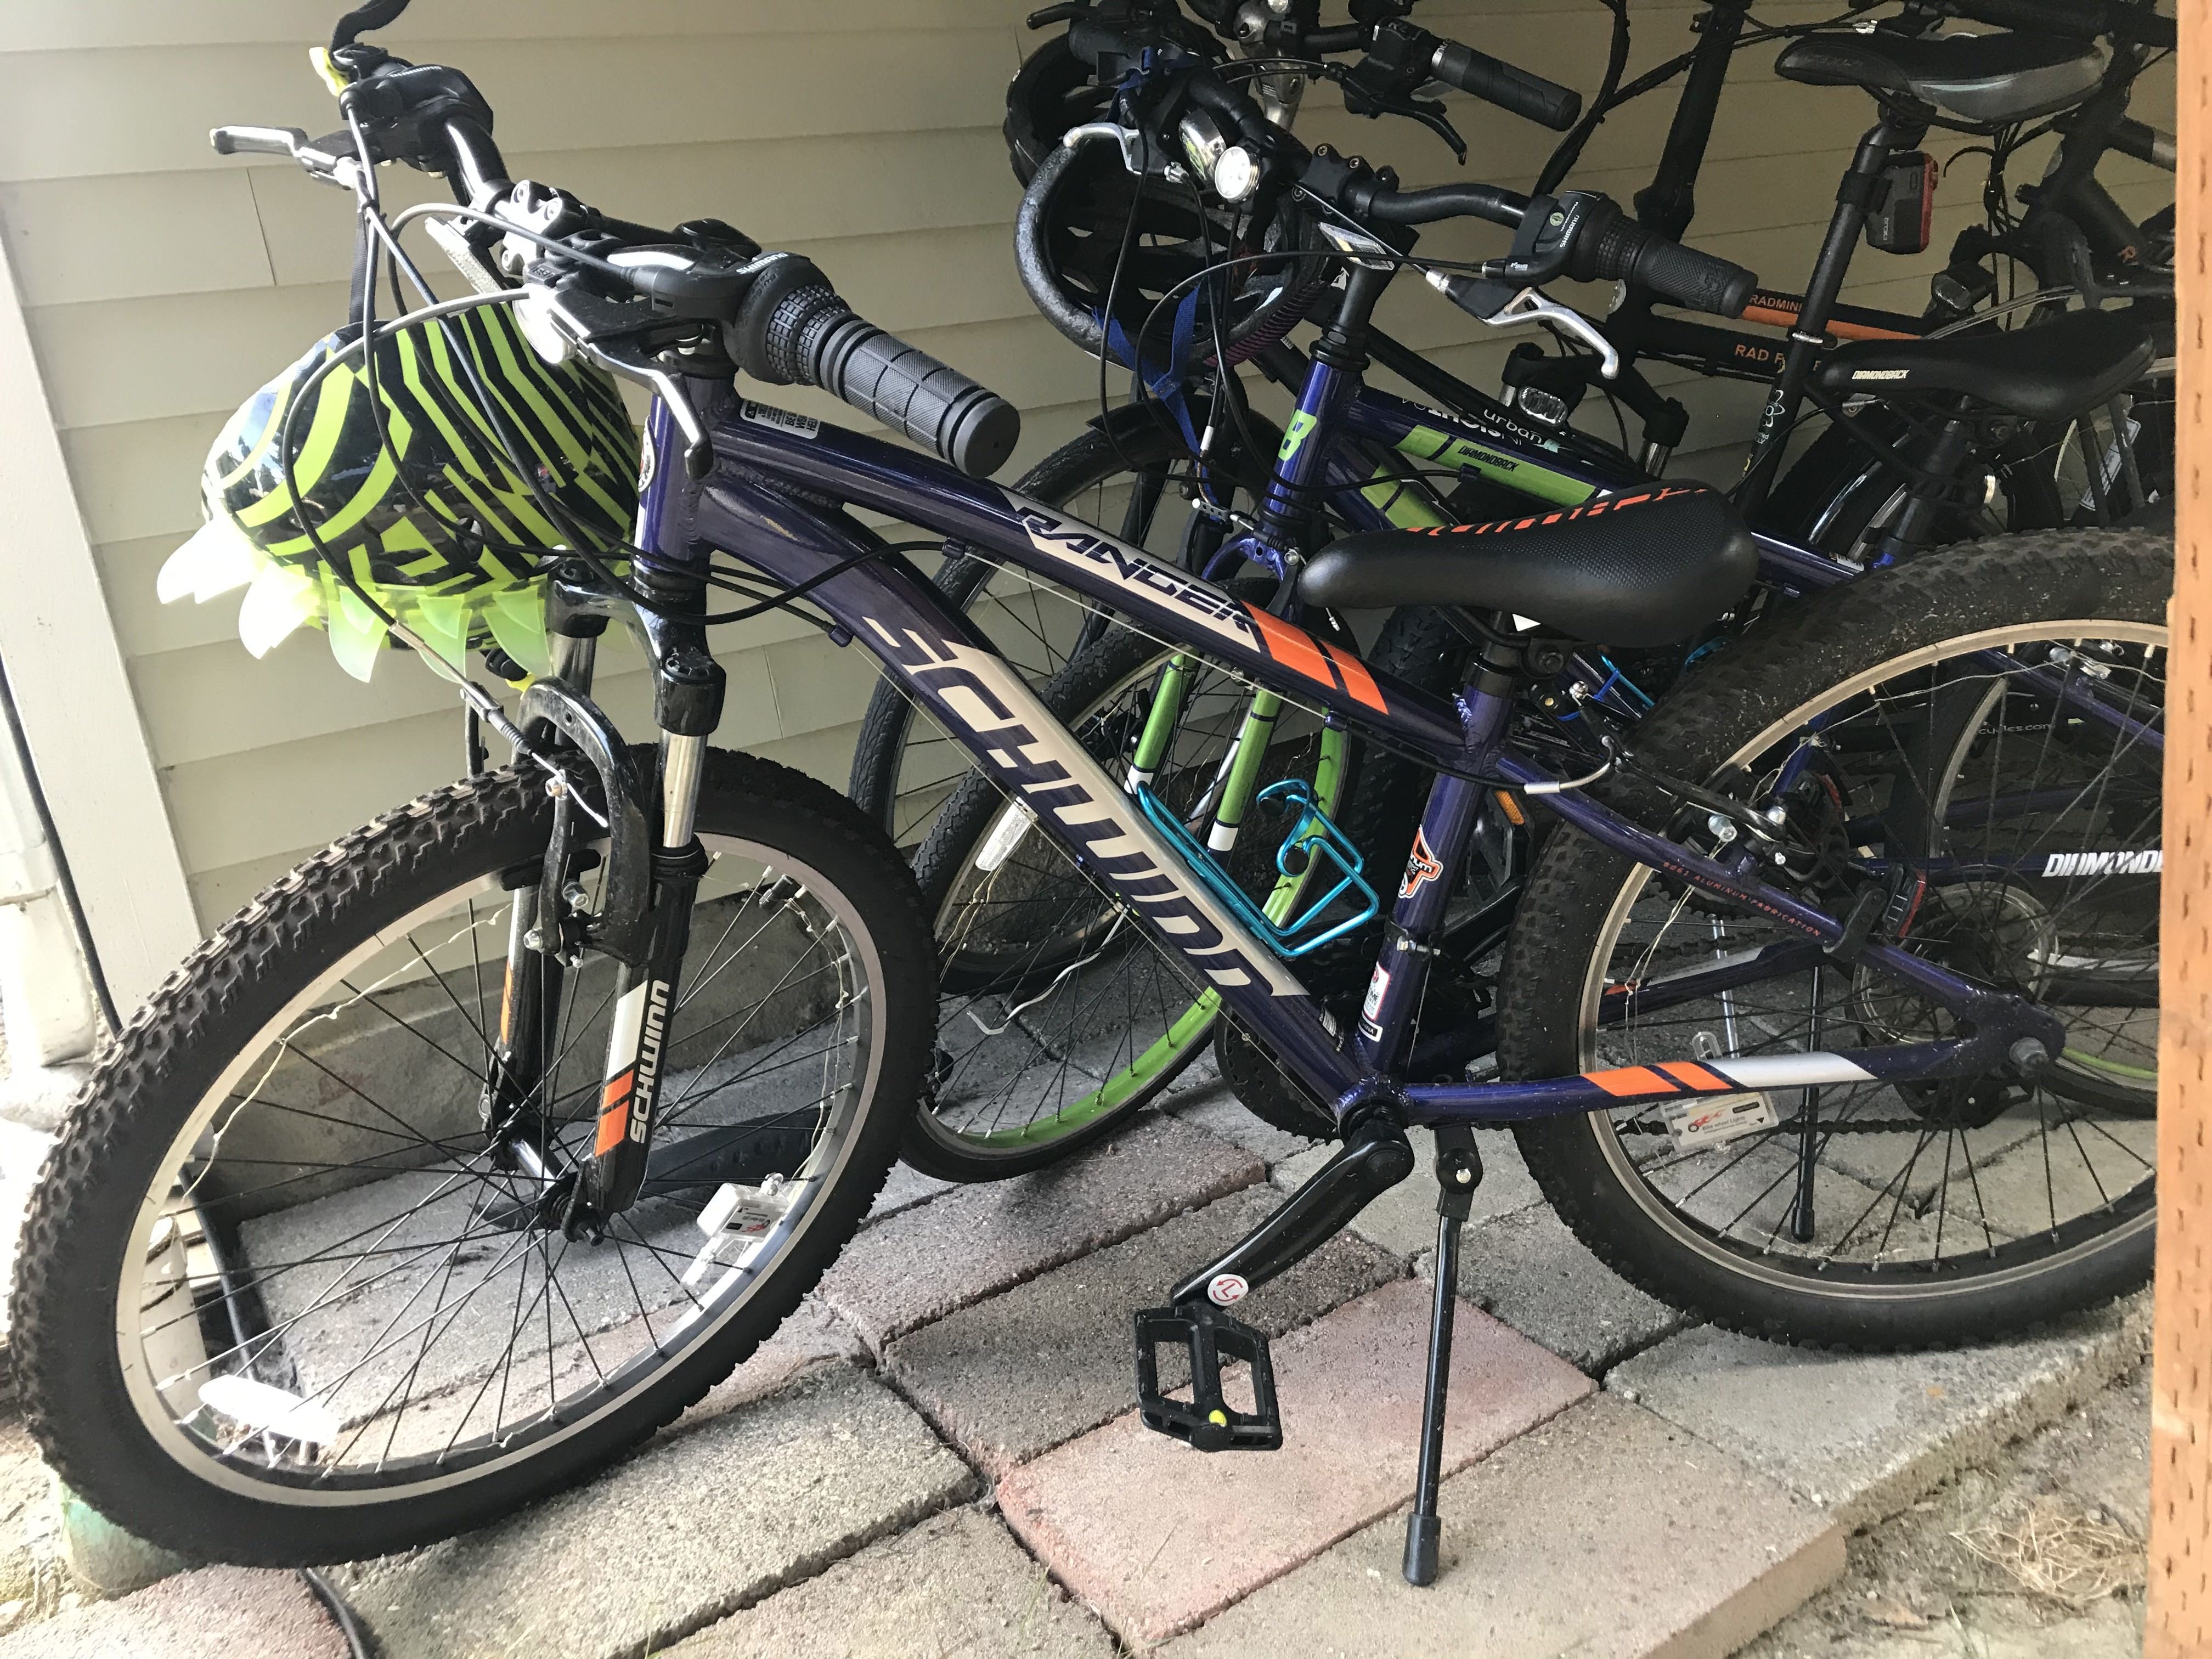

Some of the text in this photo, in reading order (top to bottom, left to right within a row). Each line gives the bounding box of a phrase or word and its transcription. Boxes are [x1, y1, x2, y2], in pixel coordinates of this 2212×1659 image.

[736, 252, 789, 274] SHIMANO
[1749, 294, 1803, 312] RADMINI
[1734, 344, 1770, 362] RAD
[1852, 369, 1910, 380] DIAMONDBACK
[1483, 409, 1542, 444] urban
[1457, 445, 1520, 472] DIAMONDBACK
[1016, 506, 1255, 634] RANGER
[860, 616, 1278, 997] SCHWINN
[1694, 874, 1747, 900] ALUMINUM
[630, 979, 670, 1144] SCHWINN
[1221, 1283, 1236, 1298] L
